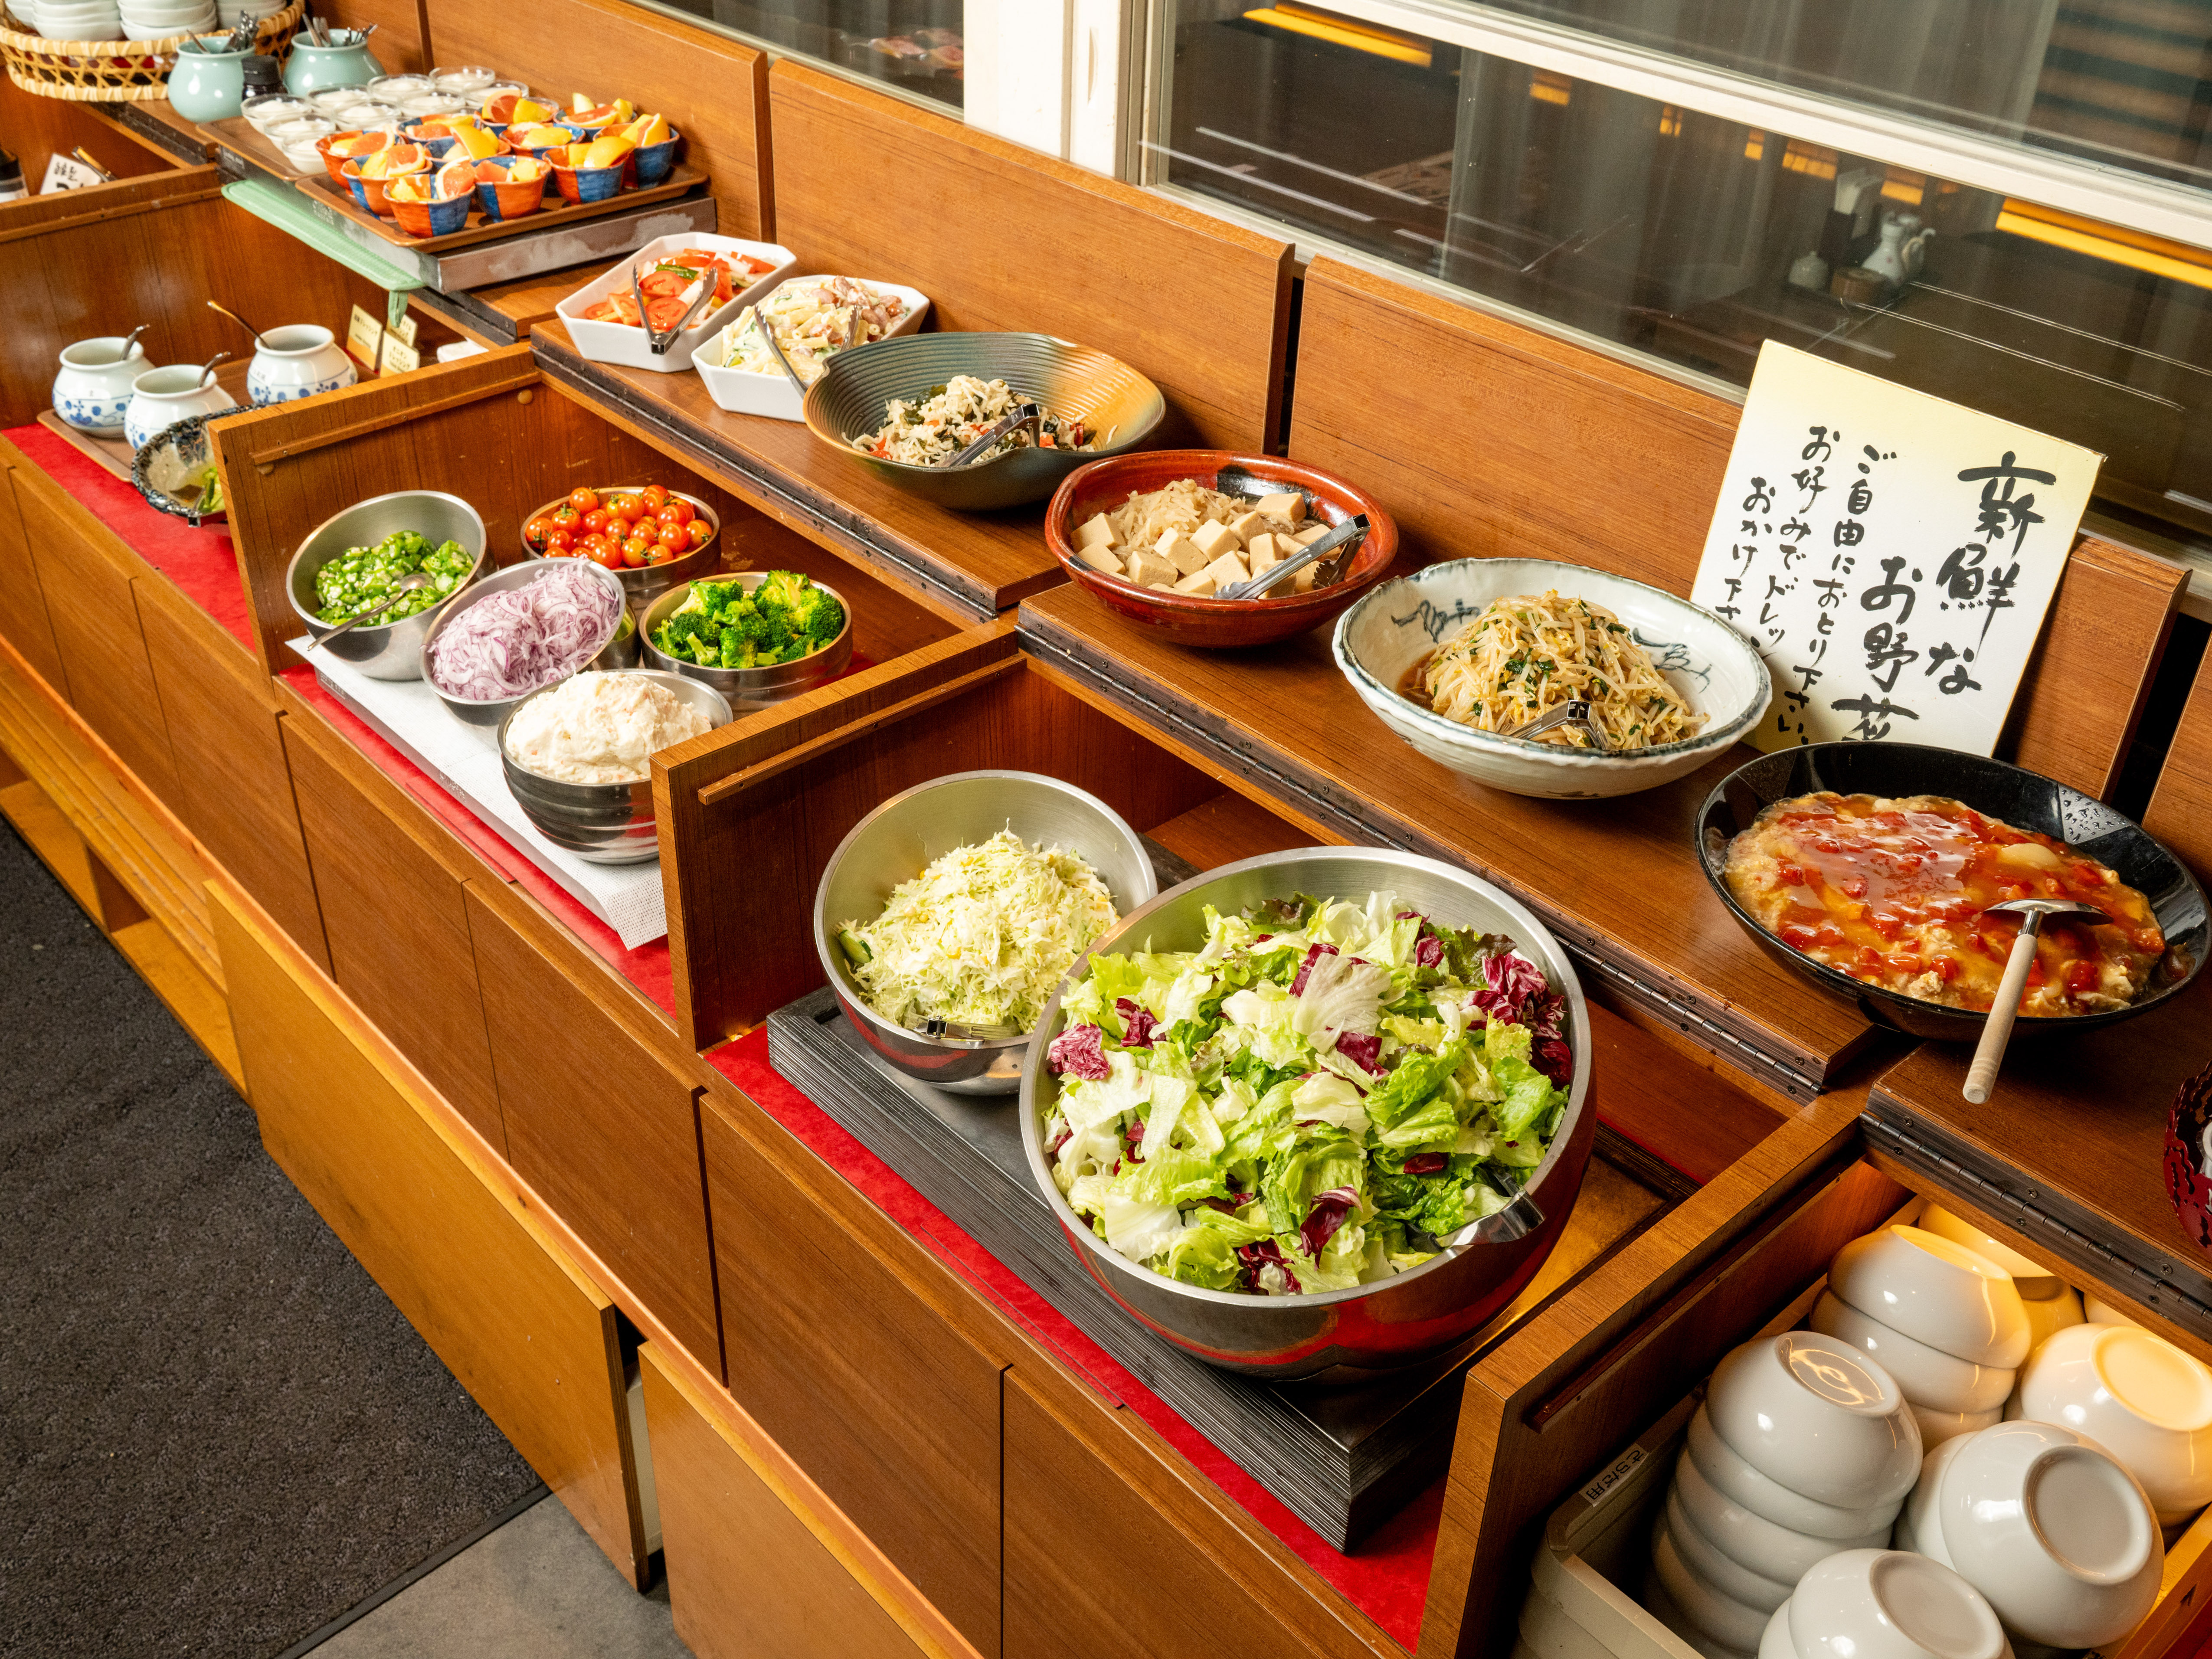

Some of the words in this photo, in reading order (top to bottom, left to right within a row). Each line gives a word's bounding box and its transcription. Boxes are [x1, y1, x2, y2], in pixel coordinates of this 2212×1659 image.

[1924, 451, 2057, 695] 新鮮な
[1586, 1450, 1644, 1500] さらだ用
